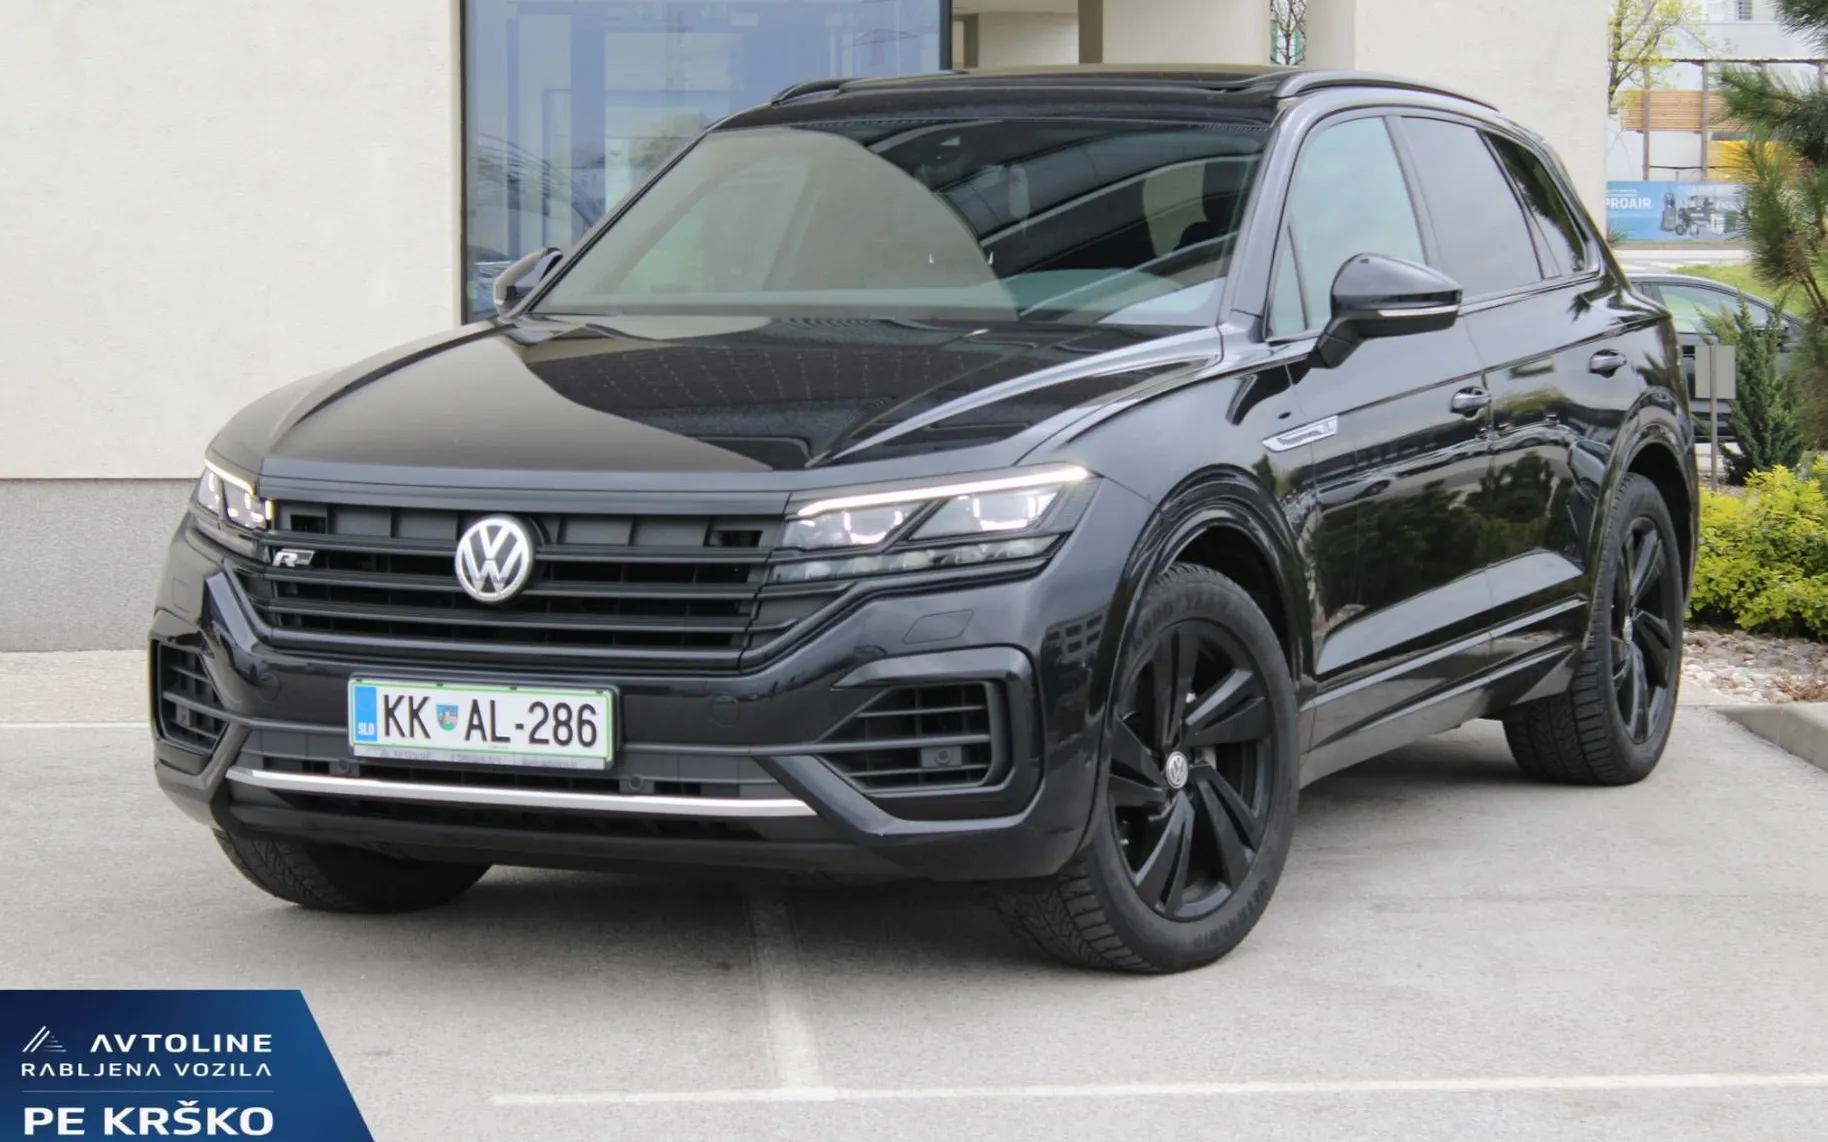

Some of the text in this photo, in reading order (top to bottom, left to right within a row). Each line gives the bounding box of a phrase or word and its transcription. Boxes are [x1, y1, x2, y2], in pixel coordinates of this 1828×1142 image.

[357, 721, 375, 736] SLO
[383, 694, 598, 748] KK AL-286
